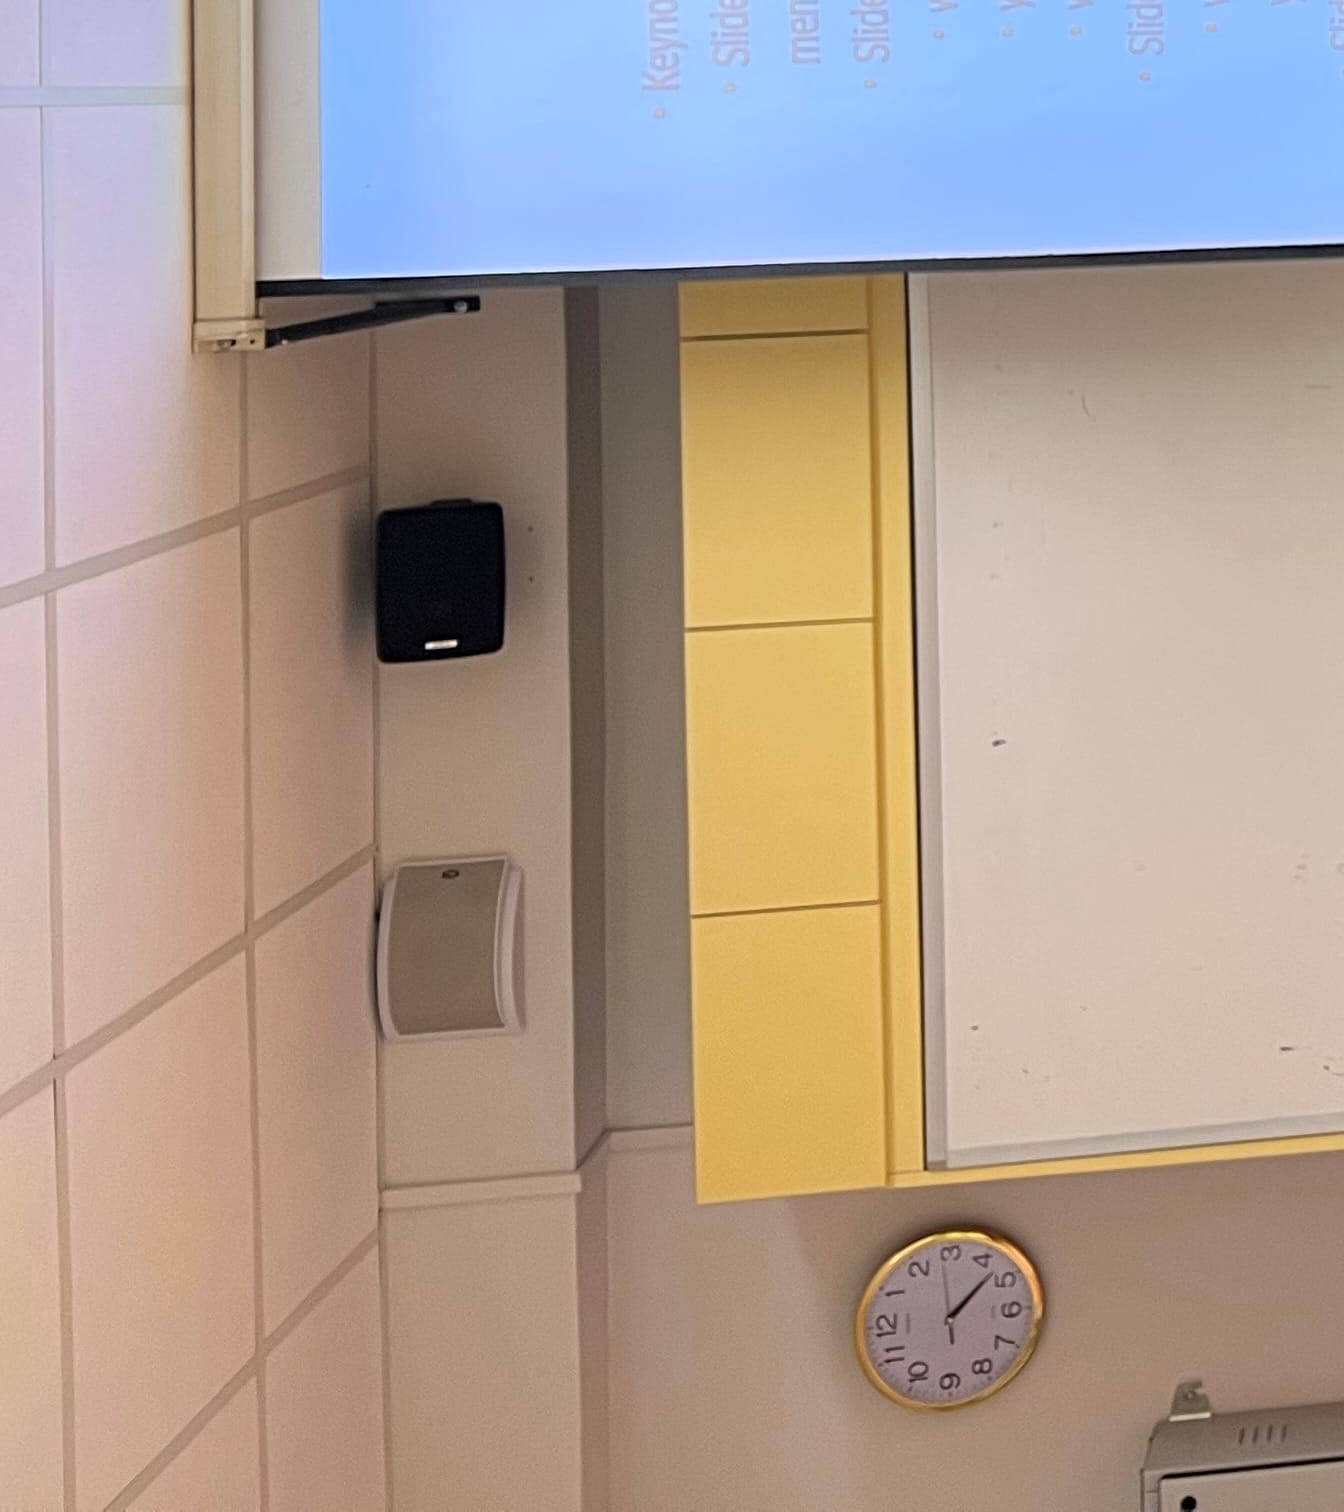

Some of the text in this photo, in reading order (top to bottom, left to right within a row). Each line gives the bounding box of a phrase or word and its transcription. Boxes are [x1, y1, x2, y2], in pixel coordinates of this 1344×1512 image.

[940, 1245, 961, 1262] 3
[972, 1253, 993, 1269] 4
[908, 1260, 929, 1278] 2
[994, 1271, 1016, 1288] 5
[885, 1289, 905, 1297] 1
[1001, 1301, 1022, 1319] 6
[875, 1313, 897, 1338] 12
[994, 1334, 1016, 1350] 7
[884, 1345, 905, 1363] 11
[907, 1361, 929, 1383] 10
[971, 1358, 993, 1375] 8
[939, 1373, 961, 1390] 9
